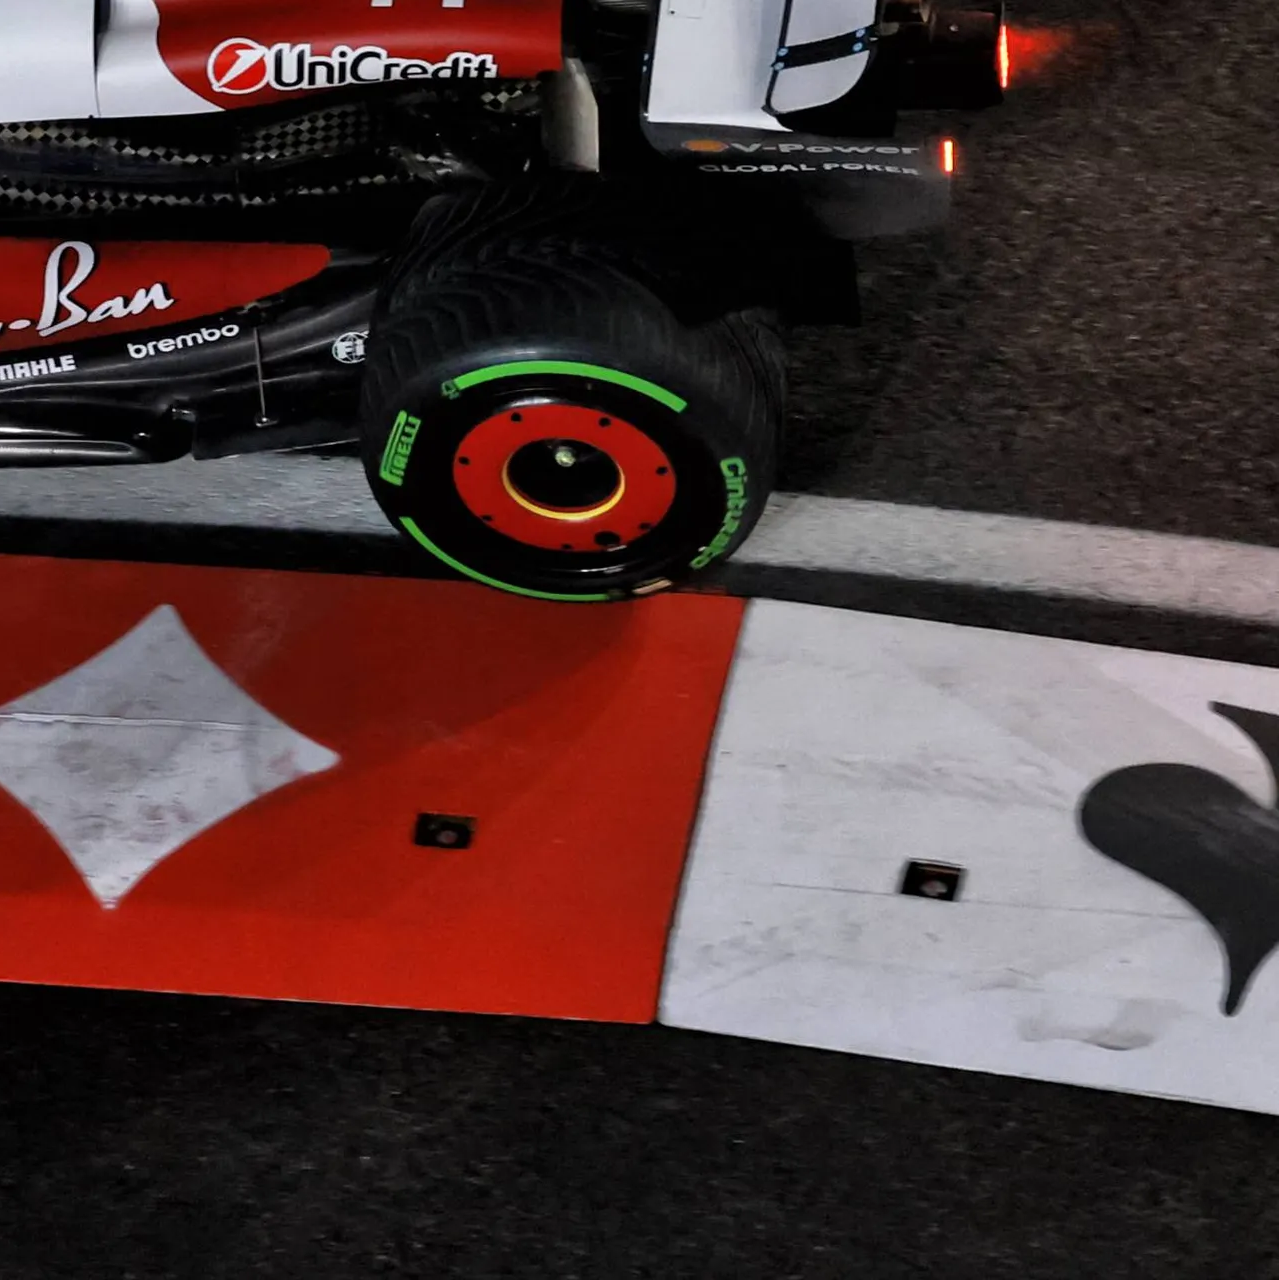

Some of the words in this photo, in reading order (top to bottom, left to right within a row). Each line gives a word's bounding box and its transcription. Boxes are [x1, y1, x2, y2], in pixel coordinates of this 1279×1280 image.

[270, 43, 497, 91] UniCredit
[698, 163, 816, 174] GLOBAL
[823, 162, 921, 176] POKER
[127, 323, 240, 359] brembo
[380, 410, 422, 486] PIRELLI
